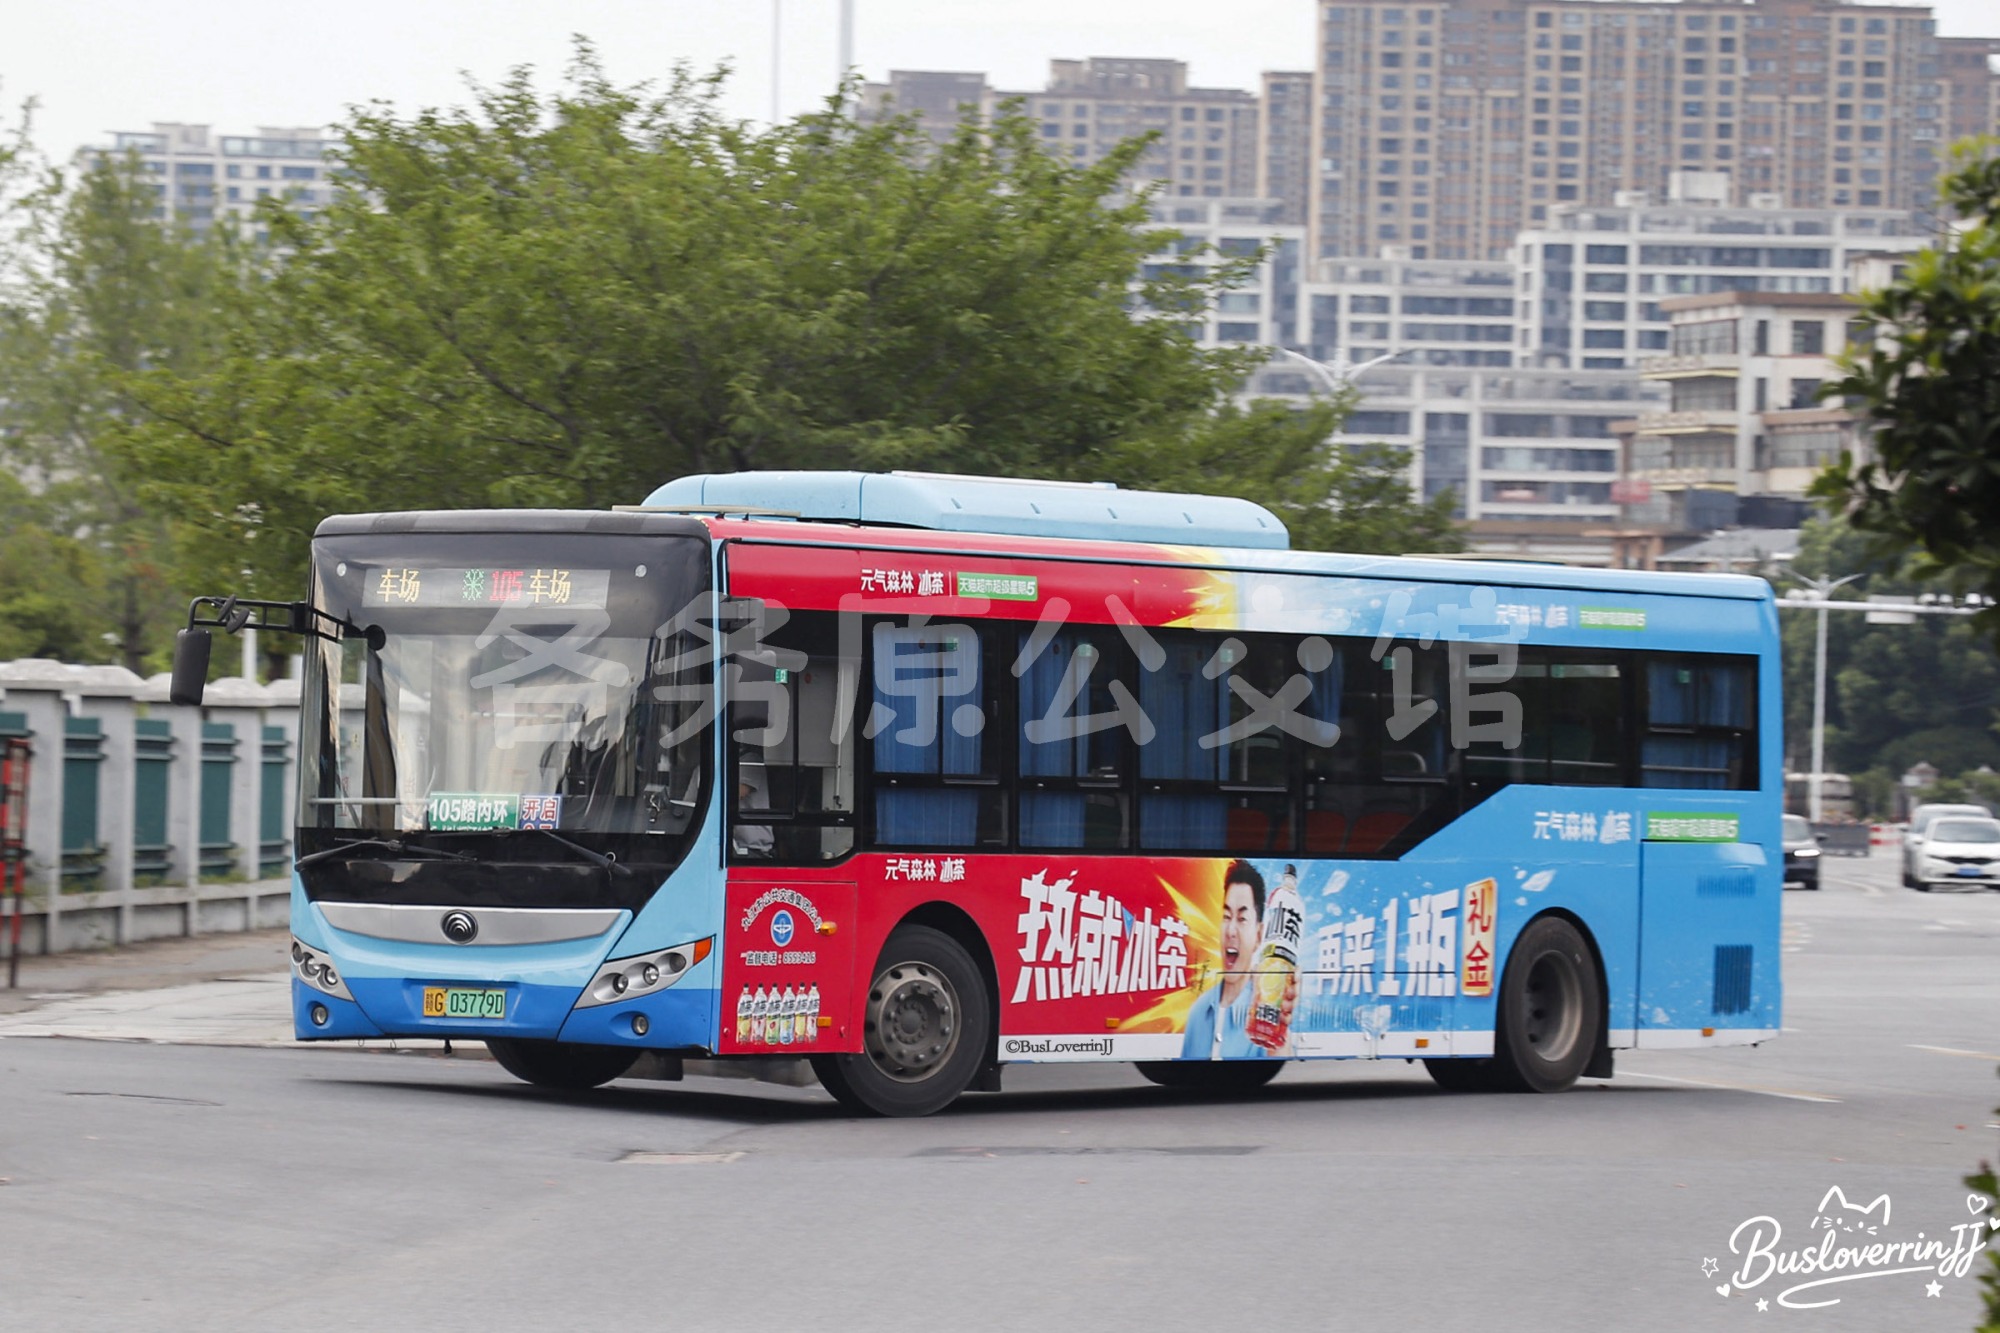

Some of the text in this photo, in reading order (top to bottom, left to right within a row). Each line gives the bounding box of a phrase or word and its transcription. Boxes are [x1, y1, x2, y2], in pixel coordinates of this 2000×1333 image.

[377, 568, 572, 603] 车场 105 车场
[861, 568, 915, 594] 元气森林
[917, 569, 945, 596] 冰茶
[430, 797, 509, 823] 105路内环
[522, 797, 558, 821] 开启
[1533, 810, 1598, 842] 元气森林
[884, 857, 966, 883] 元气森林 冰茶
[1010, 867, 1191, 1004] 热就冰茶
[1316, 889, 1459, 997] 再来1瓶
[1464, 888, 1493, 988] 礼金
